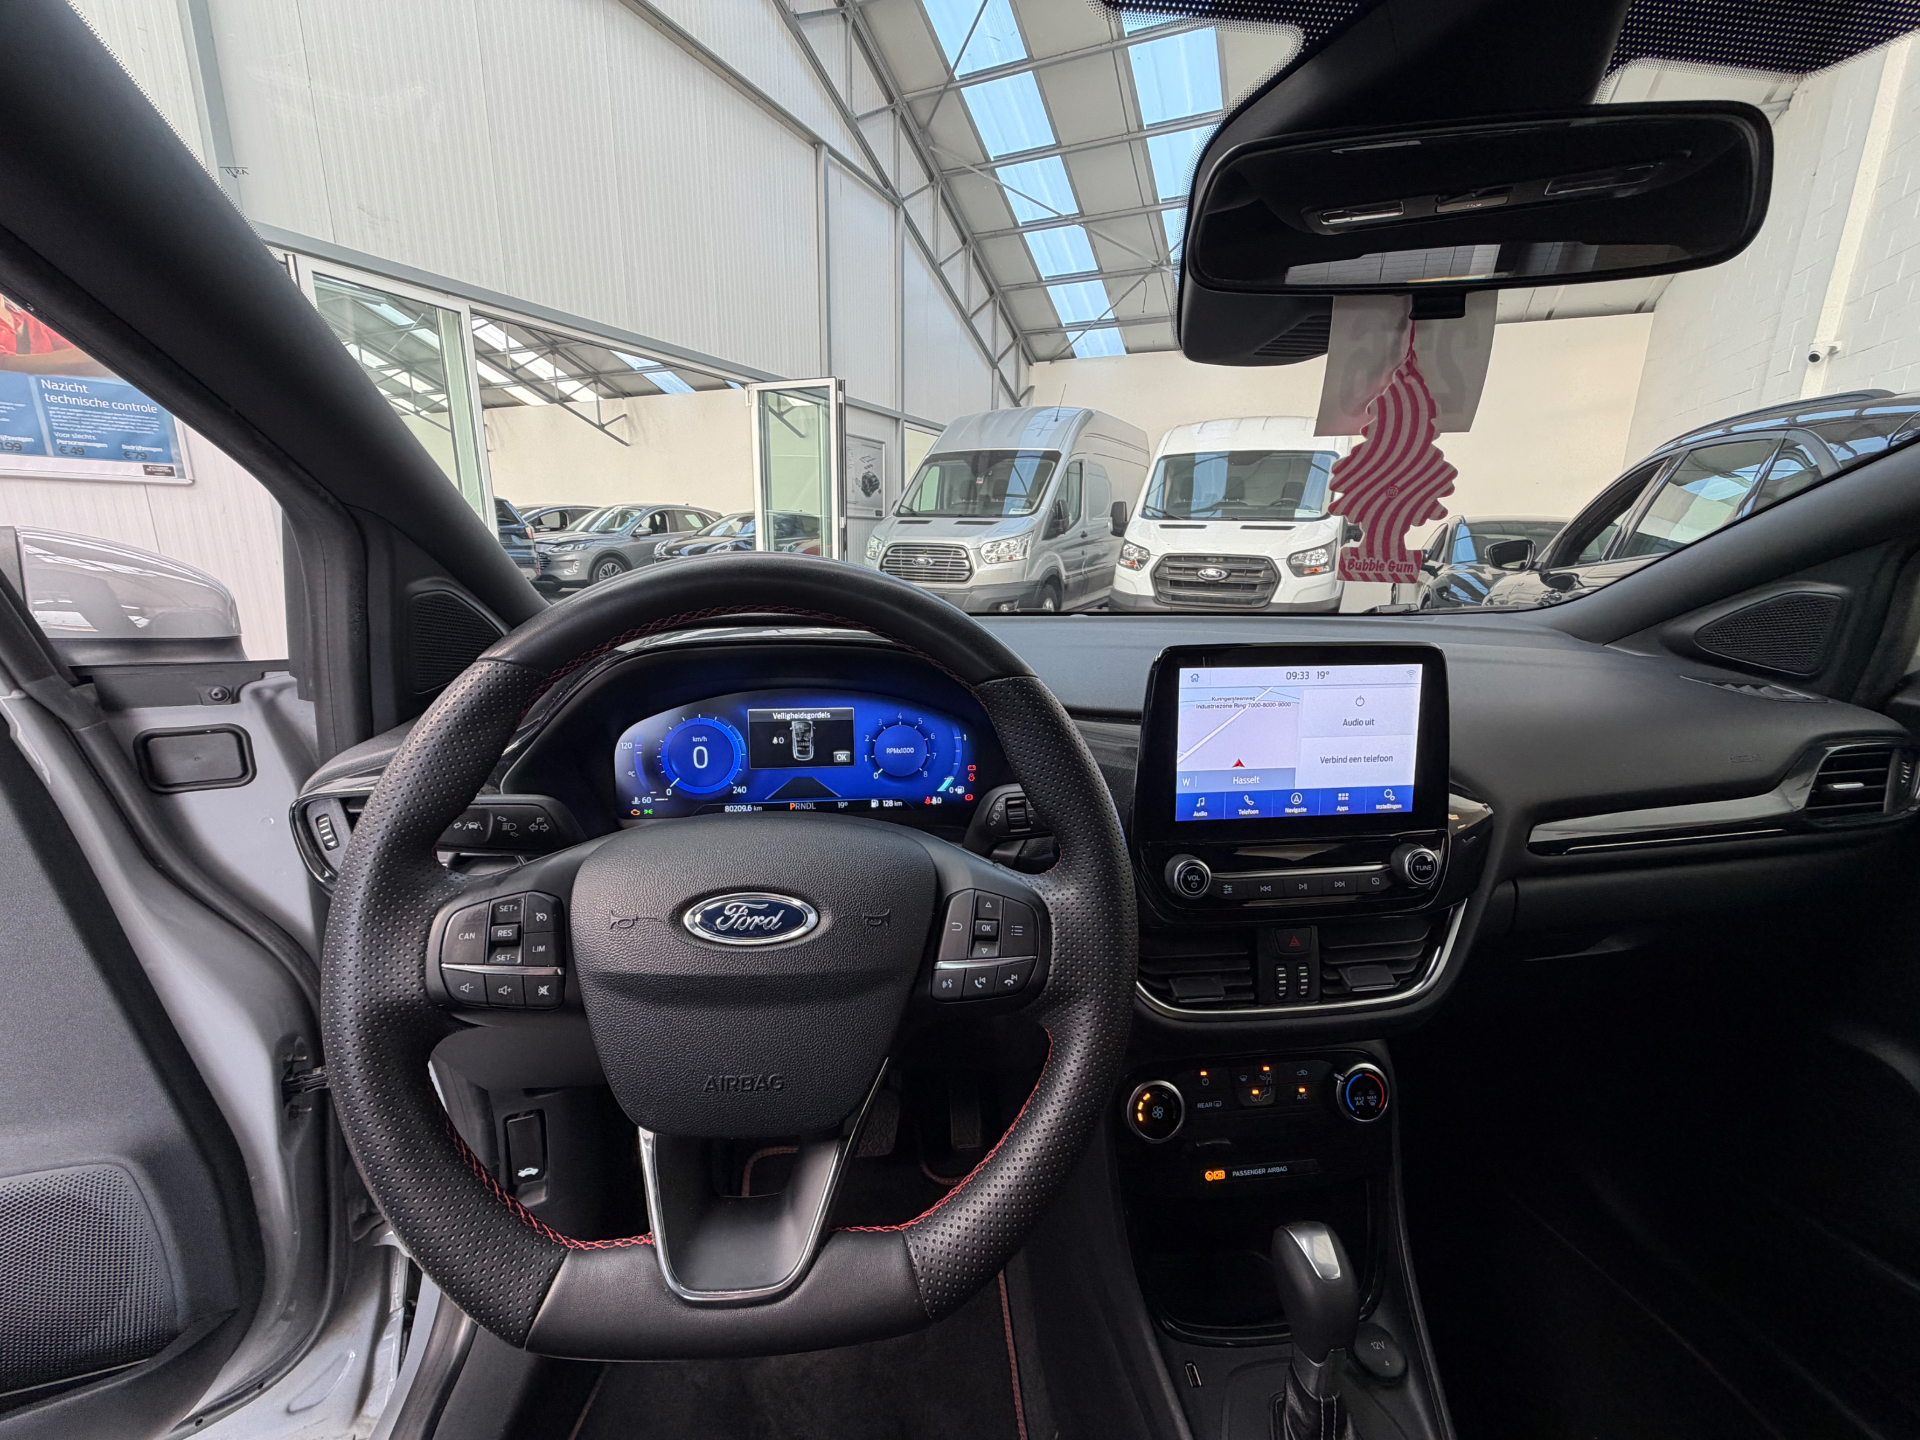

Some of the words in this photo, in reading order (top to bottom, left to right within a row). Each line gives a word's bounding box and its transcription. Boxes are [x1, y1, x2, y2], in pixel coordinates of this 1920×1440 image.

[41, 379, 89, 394] Nazicht
[44, 393, 110, 409] technische
[111, 402, 158, 414] controle
[1347, 558, 1386, 572] Bubble
[1388, 560, 1414, 573] Gum
[1286, 671, 1310, 680] 09:33
[1342, 718, 1364, 727] Audio
[1365, 718, 1375, 726] uit
[693, 746, 708, 769] 0
[1320, 756, 1348, 764] Verbind
[1363, 754, 1394, 763] telefoon
[1182, 778, 1191, 787] W
[1232, 775, 1260, 785] Hasselt
[732, 786, 747, 794] 240
[1187, 874, 1201, 882] VOL
[715, 901, 786, 932] Ford
[981, 924, 992, 932] OK
[458, 932, 476, 940] CAN
[497, 929, 512, 937] RES
[532, 945, 546, 953] LIM
[703, 1074, 785, 1093] AIRBAG
[1232, 1169, 1266, 1177] PASSENGER
[1267, 1166, 1288, 1174] AIRBAG
[1371, 1341, 1385, 1350] 12V
